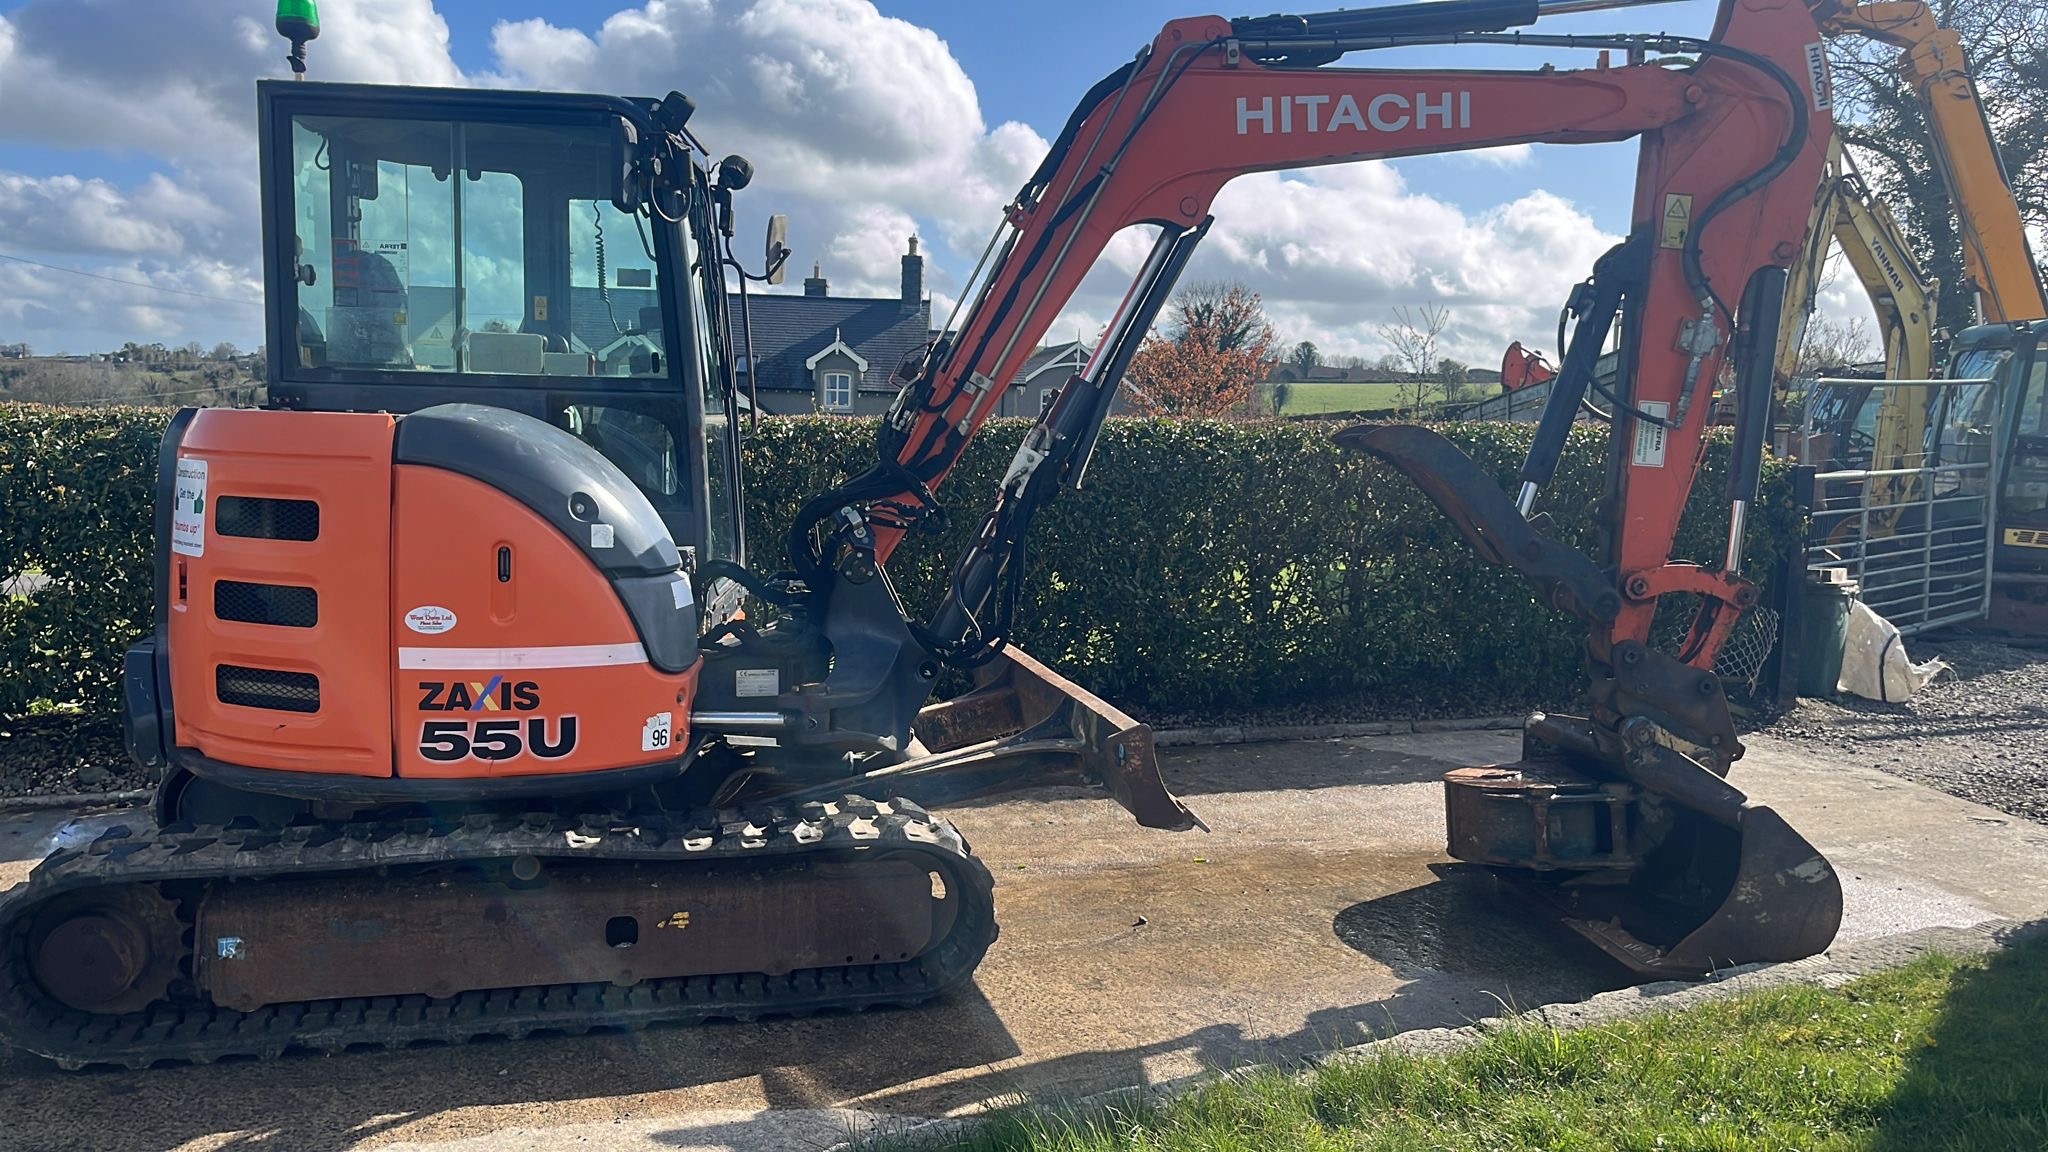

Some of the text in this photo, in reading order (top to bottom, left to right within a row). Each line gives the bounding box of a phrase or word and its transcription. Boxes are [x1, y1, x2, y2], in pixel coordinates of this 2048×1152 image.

[1236, 91, 1470, 134] HITACHI
[1872, 237, 1904, 292] YANMAR
[418, 675, 541, 711] ZAXIS
[418, 716, 577, 761] 55U
[652, 729, 668, 747] 96
